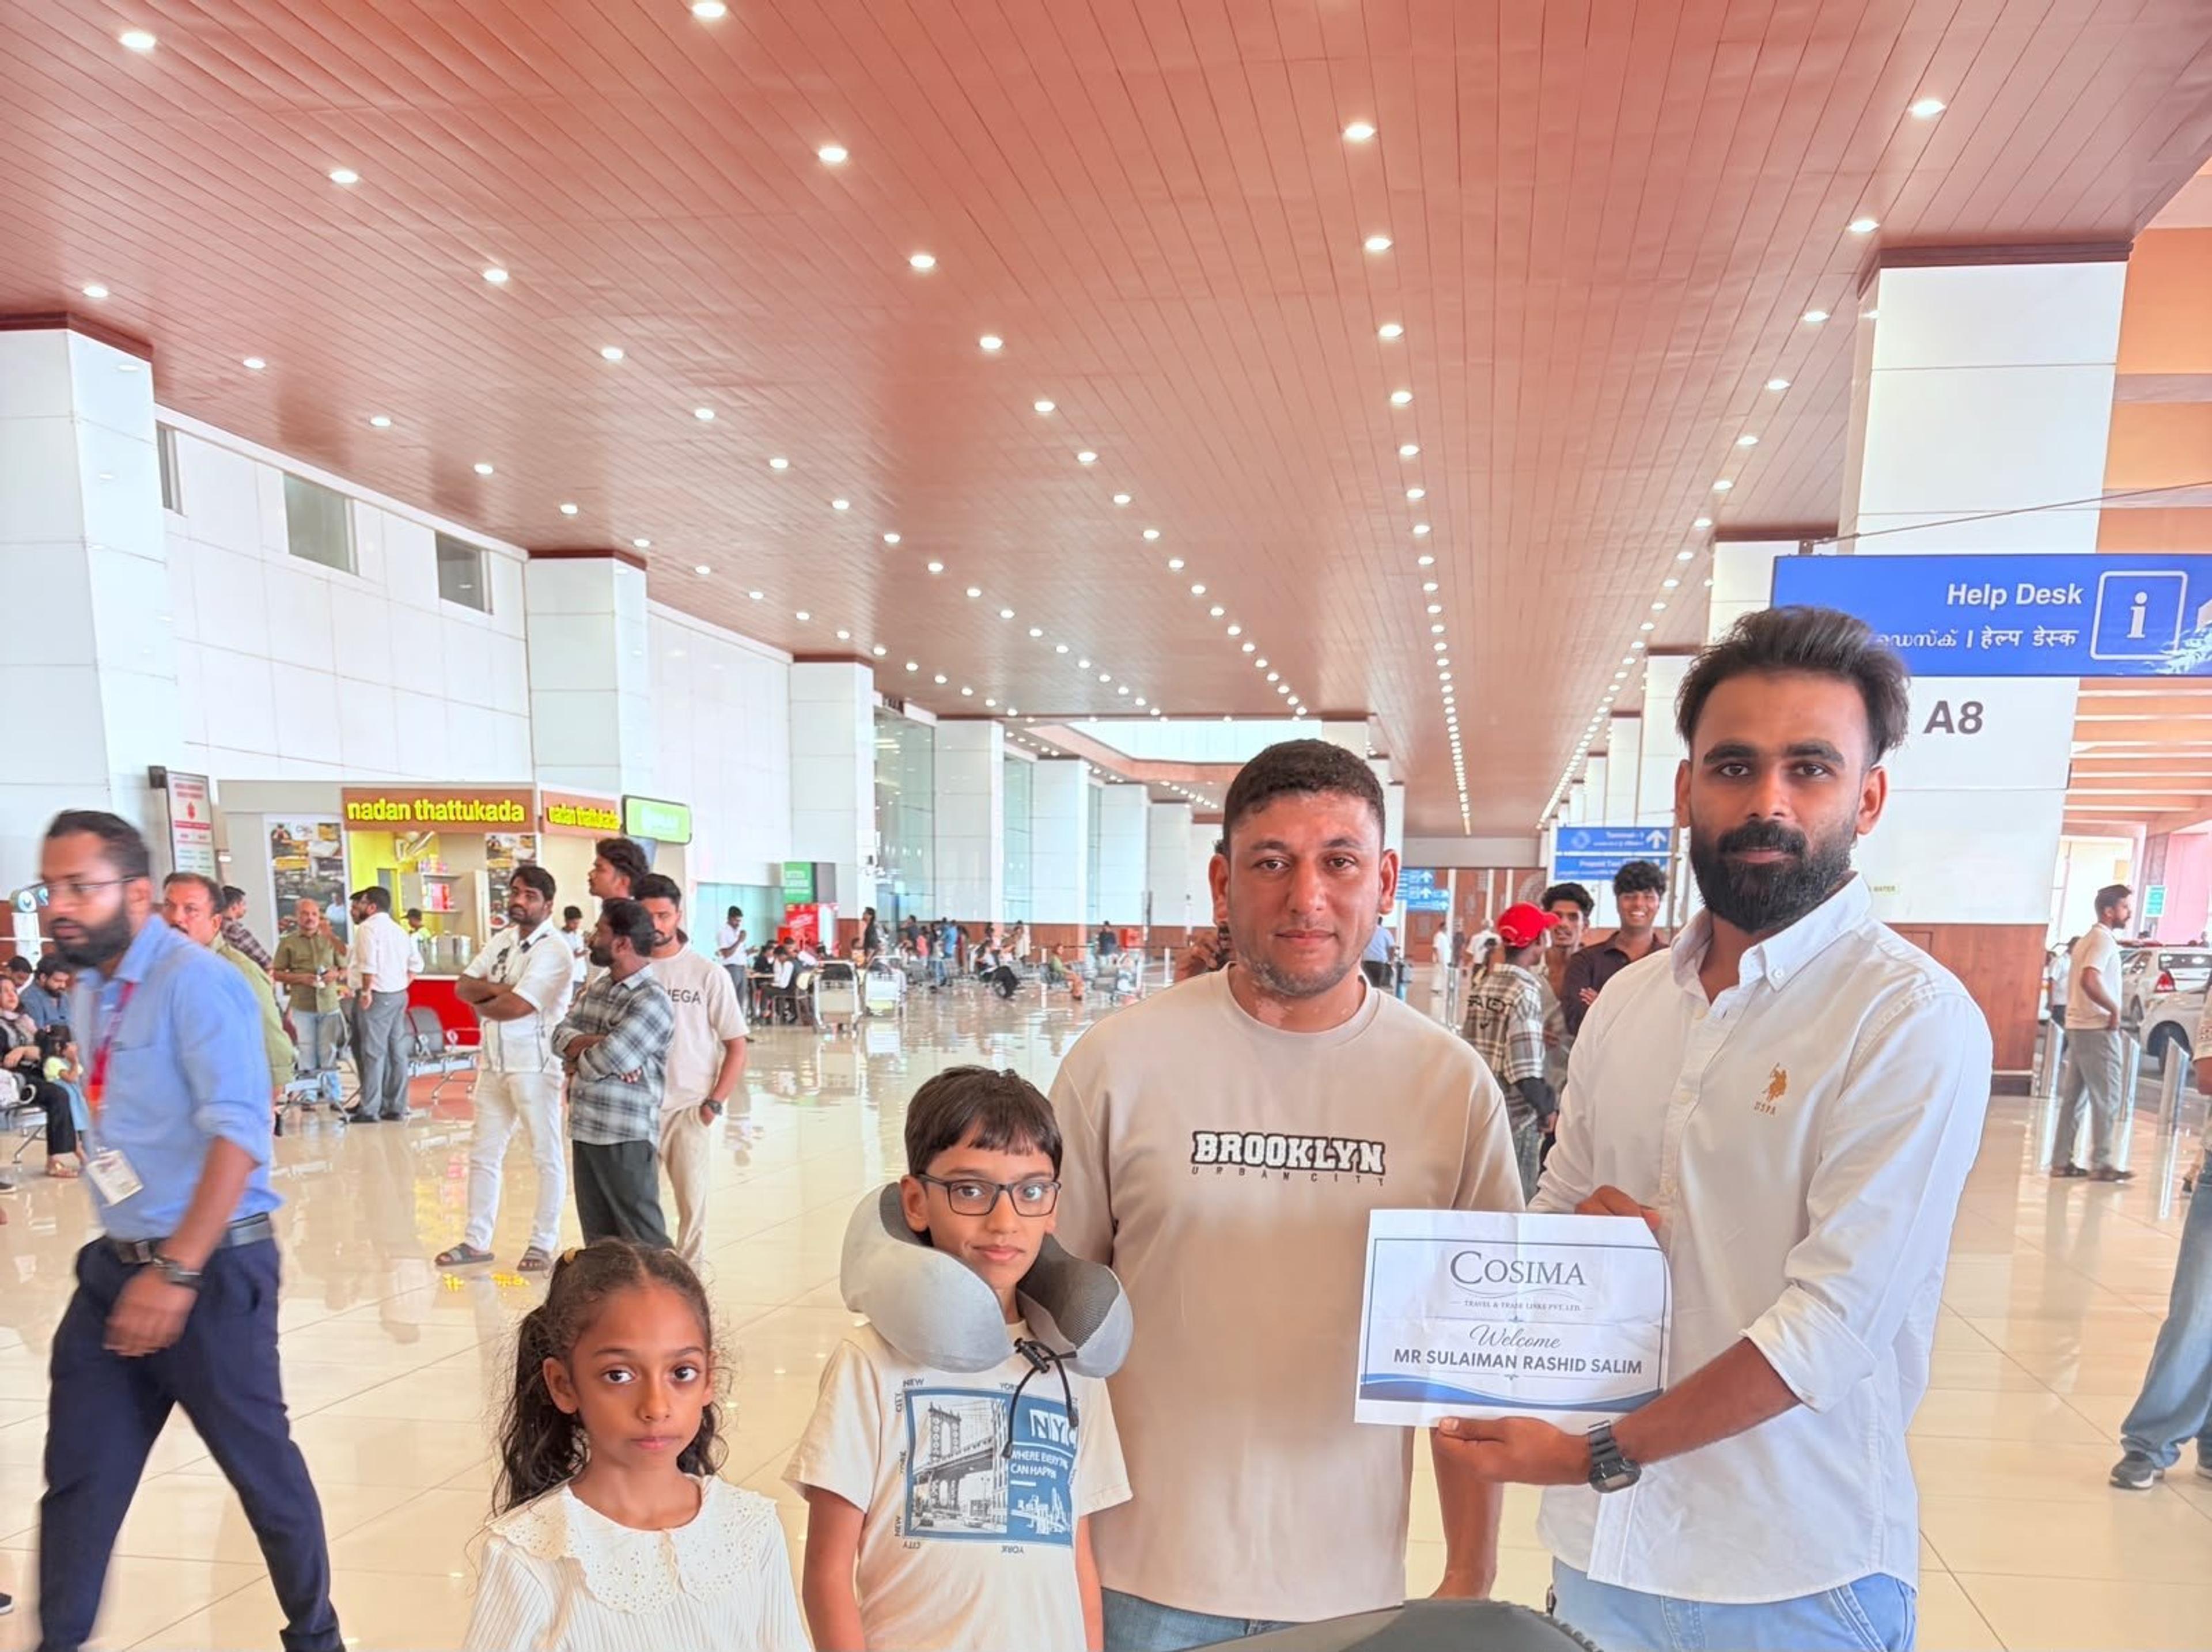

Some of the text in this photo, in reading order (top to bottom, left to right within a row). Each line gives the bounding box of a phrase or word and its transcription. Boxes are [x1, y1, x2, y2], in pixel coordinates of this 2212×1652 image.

[1946, 582, 2084, 611] Help Desk
[1981, 626, 2080, 650] हेल्प डेस्क
[1923, 700, 1983, 734] A8
[347, 798, 525, 822] nadan thattukada
[667, 988, 702, 1005] EGA
[1191, 1131, 1385, 1174] BROOKLYN
[1191, 1166, 1290, 1181] URBAN
[1450, 1251, 1586, 1286] COSIMA
[1469, 1324, 1560, 1350] Welcome
[1393, 1348, 1642, 1375] MR SULAIMAN RASHID SALIM
[1010, 1462, 1029, 1475] CAN
